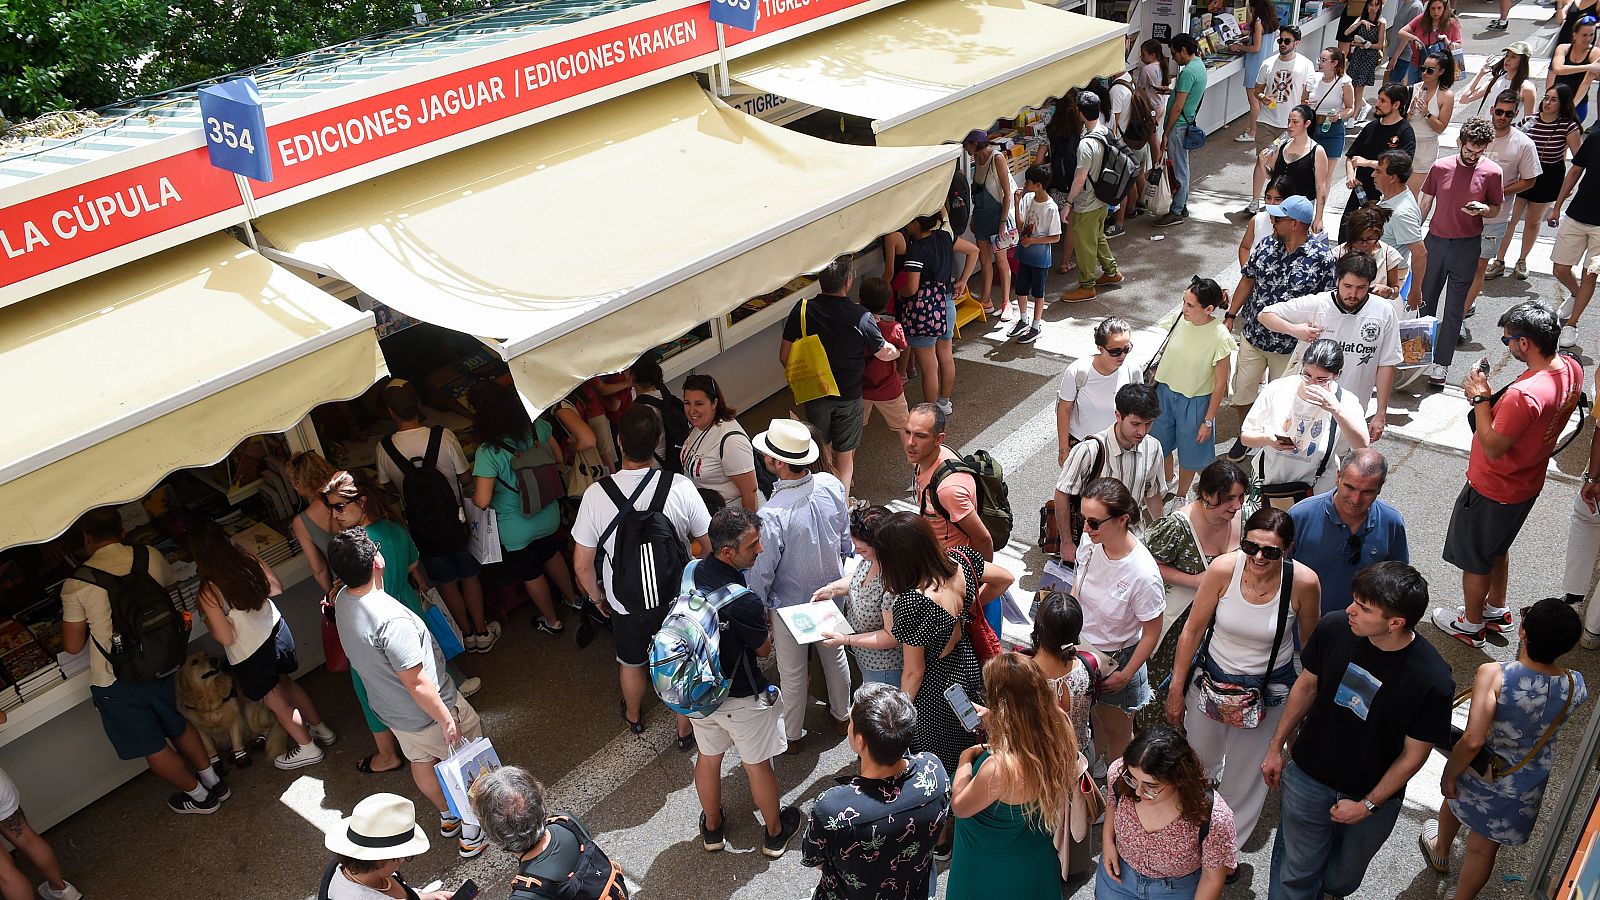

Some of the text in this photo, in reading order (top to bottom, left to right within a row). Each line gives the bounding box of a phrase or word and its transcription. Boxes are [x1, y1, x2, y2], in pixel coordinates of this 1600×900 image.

[277, 18, 697, 167] EDICIONES JAGUAR / EDICIONES KRAKEN
[207, 117, 255, 154] 354
[0, 176, 183, 259] LA CÚPULA
[1356, 343, 1377, 354] Crew
